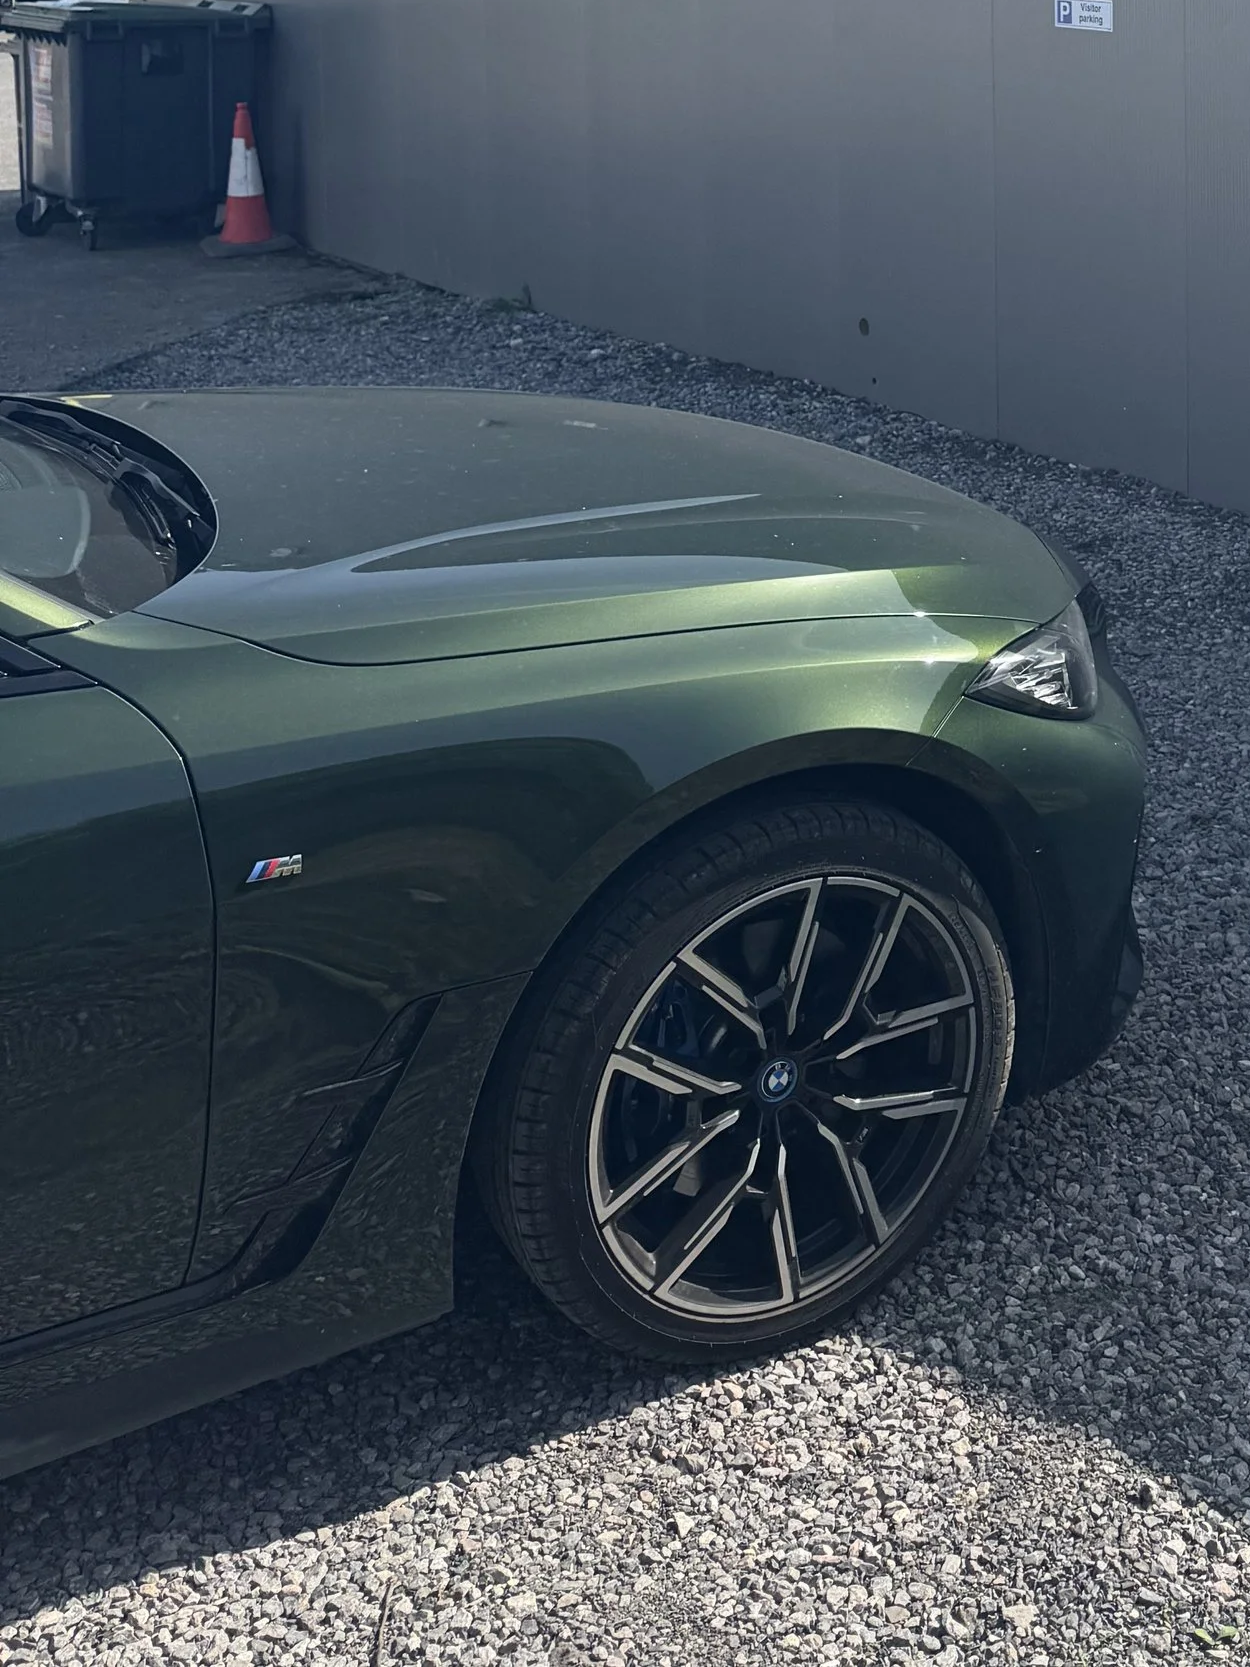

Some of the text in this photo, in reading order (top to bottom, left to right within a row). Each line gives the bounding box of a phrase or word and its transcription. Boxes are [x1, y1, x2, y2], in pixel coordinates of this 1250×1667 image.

[1060, 1, 1070, 22] P
[1080, 3, 1101, 13] Visitor
[1079, 15, 1103, 26] parking
